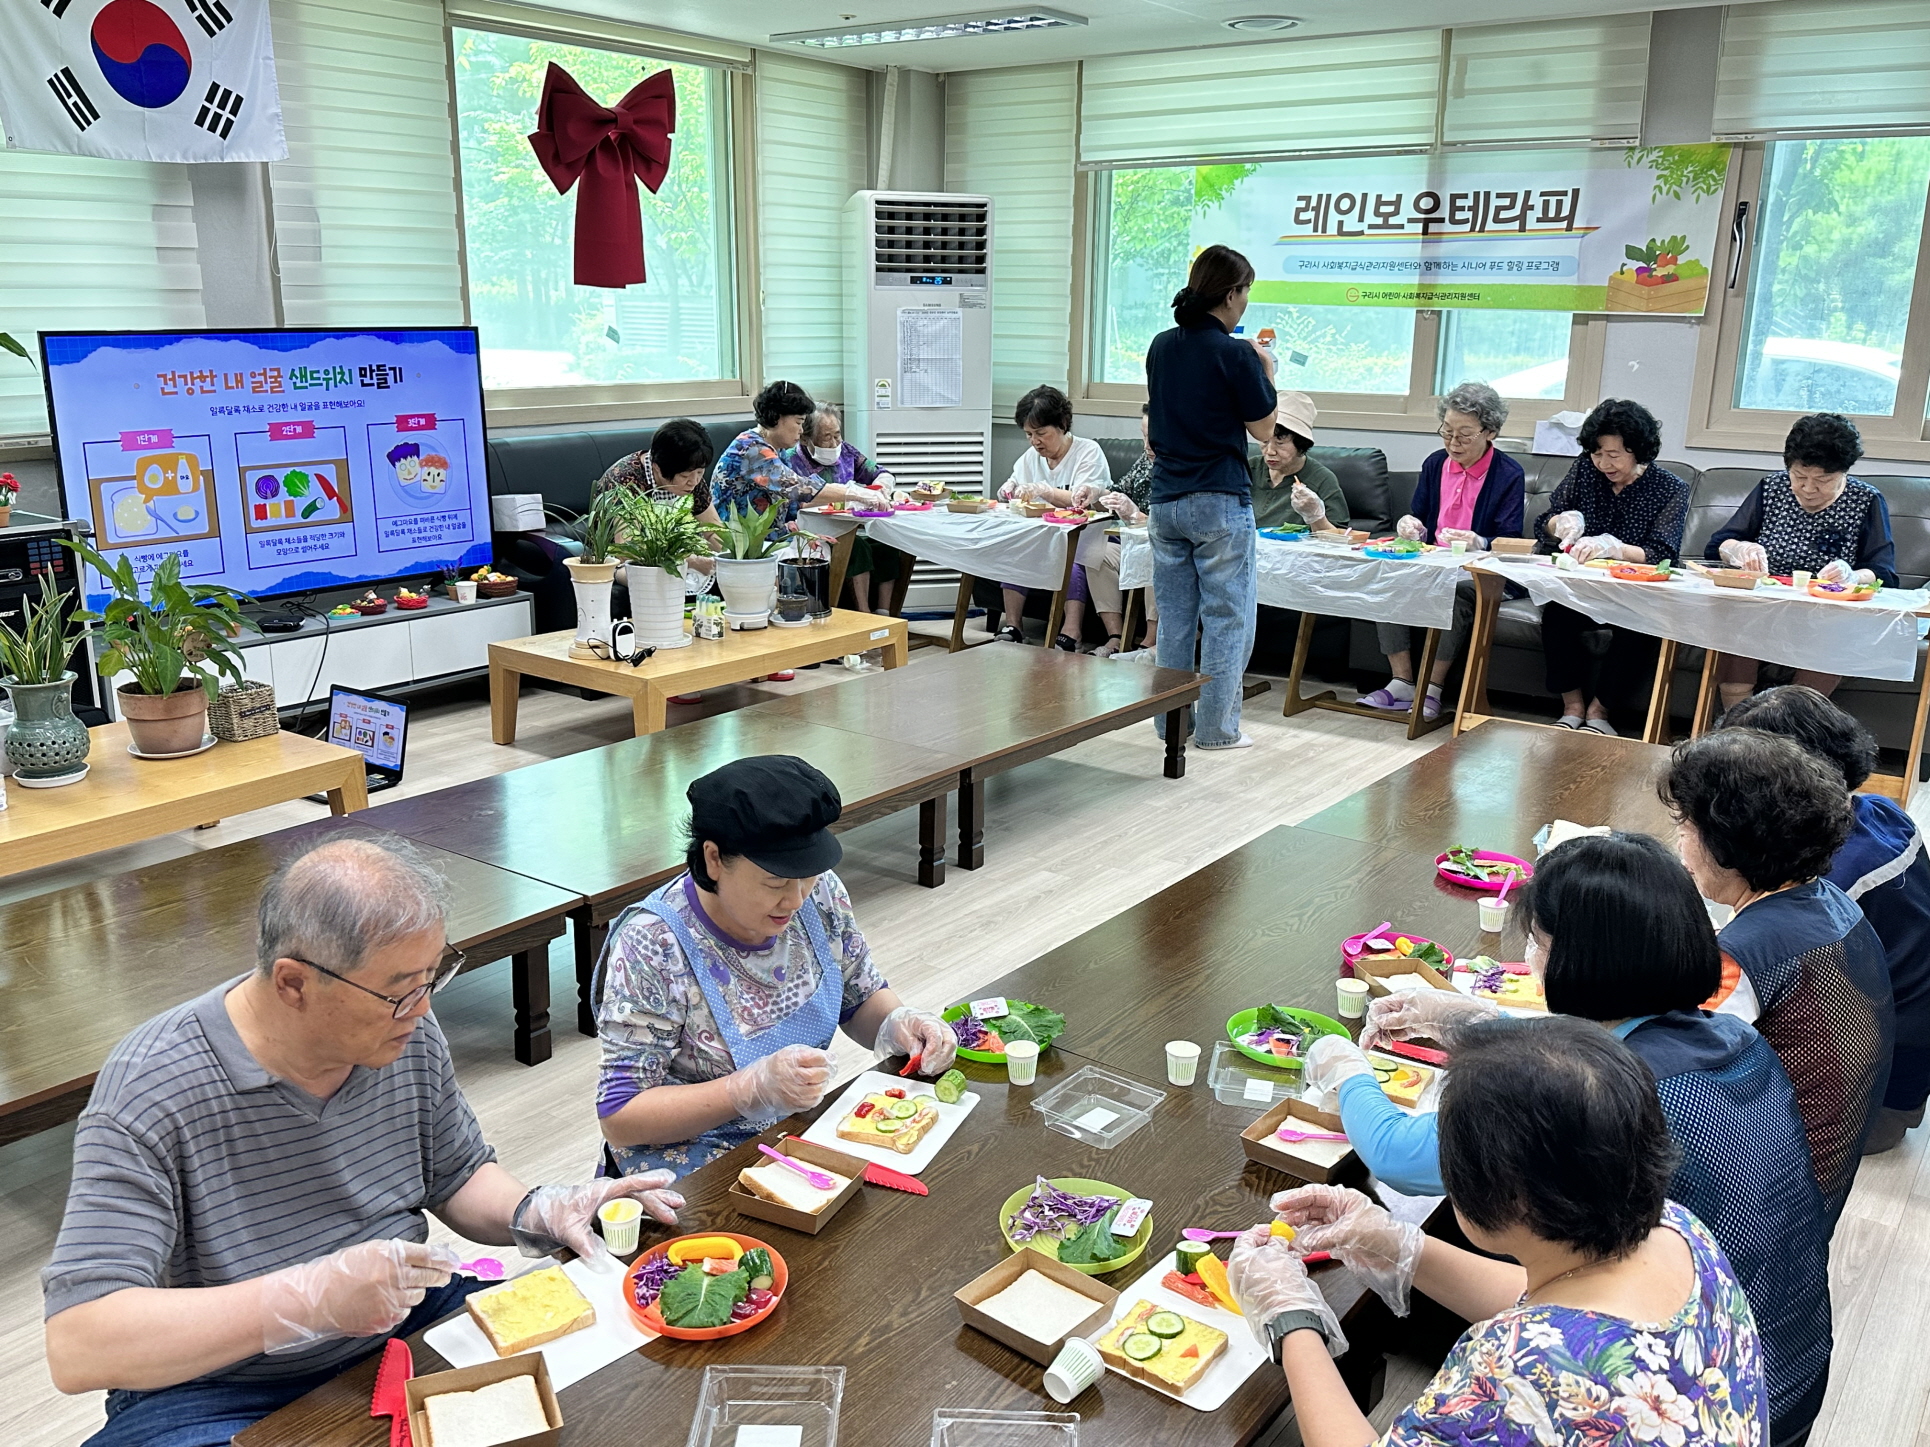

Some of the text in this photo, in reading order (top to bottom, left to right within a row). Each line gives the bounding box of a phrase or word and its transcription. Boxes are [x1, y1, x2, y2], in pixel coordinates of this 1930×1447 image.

[1293, 188, 1580, 237] 레인보우테라피
[1298, 260, 1560, 272] 구리시 사회복지급식관리지원센터와 함께하는 시니어 푸드 힐링 프로그램
[1361, 291, 1381, 300] 구리시
[157, 364, 404, 396] 건강한 내 얼굴 샌드위치 만들기
[209, 405, 241, 417] 알록달록
[242, 404, 265, 415] 채소로
[267, 402, 289, 413] 건강한
[290, 402, 298, 412] 내
[299, 401, 320, 412] 얼굴을
[407, 417, 426, 427] 3단계
[281, 425, 302, 436] 2단계
[136, 433, 158, 446] 1단계
[327, 531, 346, 540] 크기와
[134, 553, 155, 563] 식빵에
